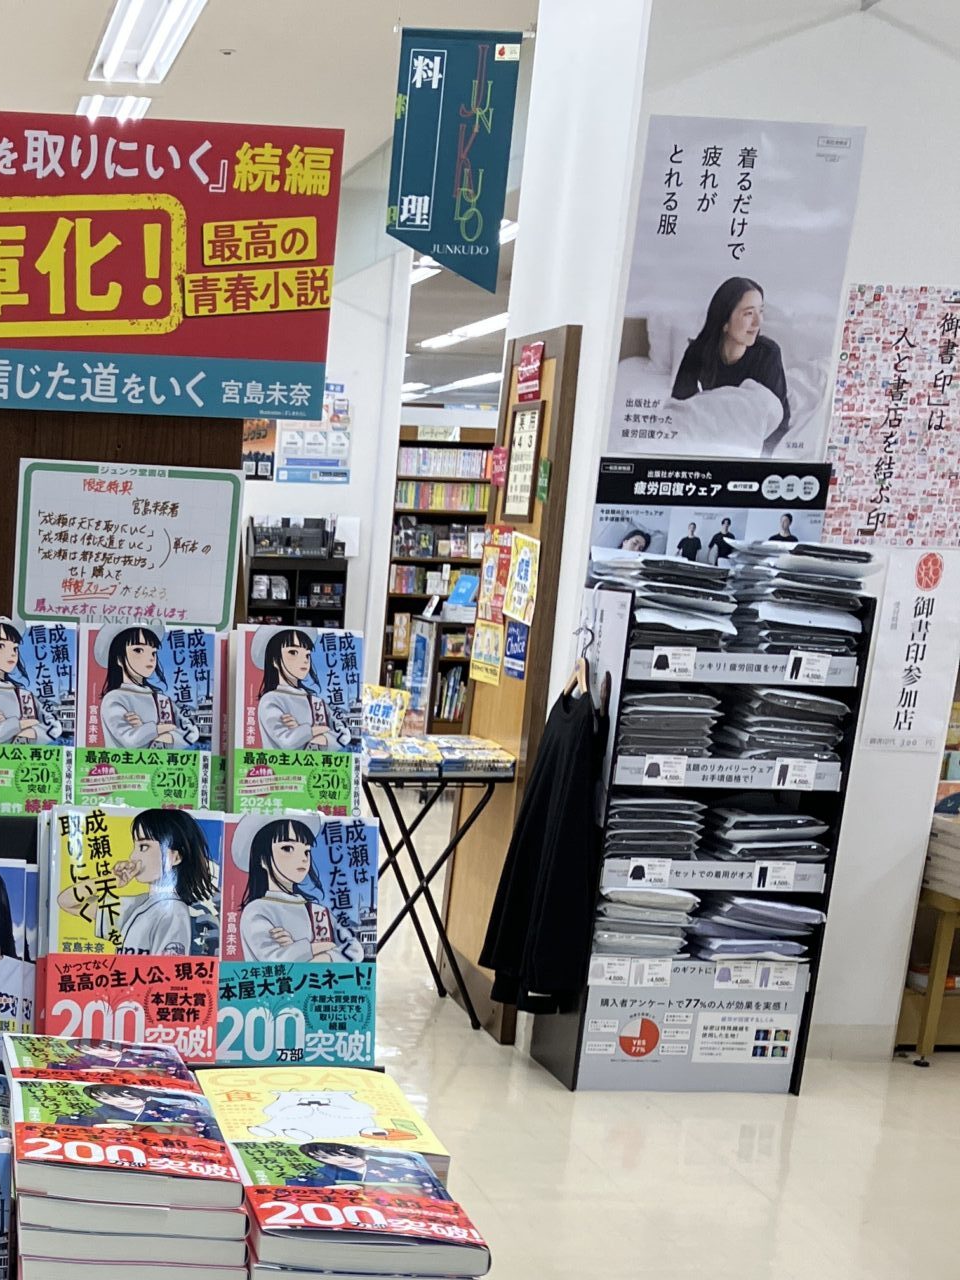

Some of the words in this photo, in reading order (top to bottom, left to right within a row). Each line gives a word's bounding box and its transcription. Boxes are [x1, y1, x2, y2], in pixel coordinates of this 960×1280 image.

[233, 141, 334, 197] 続編
[696, 146, 724, 213] 疲れが
[656, 144, 685, 236] とれる服
[727, 146, 758, 260] 着るだけで
[207, 222, 310, 263] 最高の
[430, 243, 489, 255] JUNKUDO
[187, 270, 330, 312] 青春小説
[221, 379, 312, 407] 宮島未奈
[625, 398, 661, 409] 出版社が
[621, 428, 679, 440] 疲労回復ウェア
[624, 414, 673, 425] 本気で作った
[867, 327, 916, 531] 人と書店を結ぶ印
[101, 466, 167, 478] ジュンク堂書店
[633, 480, 722, 497] 疲労回復ウェア
[647, 469, 713, 480] 出版社が本気で作った
[49, 625, 69, 679] 成瀬は
[187, 629, 209, 682] 成瀬は
[339, 631, 359, 685] 成瀬は
[893, 597, 935, 731] 御書印参加店
[28, 625, 57, 741] 信じた道をいく
[167, 629, 194, 746] 信じた道をいく
[319, 632, 348, 748] 信じた道をいく
[85, 751, 198, 767] 最高の主人公、再び!
[243, 752, 352, 768] 最高の主人公、再び!
[346, 820, 369, 885] 成瀬は
[85, 809, 121, 947] 成瀬は天下を
[321, 822, 356, 962] 信じた道をいく
[62, 942, 105, 954] 宮島未奈
[226, 911, 237, 955] 宮島未奈
[58, 960, 215, 993] 最高の主人公、現る!
[62, 959, 110, 974] かつてなく
[220, 966, 373, 1001] 本屋大賞ノミネート!
[241, 964, 287, 980] 2年連続
[151, 992, 207, 1008] 本屋大賞
[156, 1008, 200, 1023] 受賞作
[217, 1007, 305, 1060] 200
[276, 1048, 304, 1062] 万部
[305, 1029, 372, 1062] 突破!
[23, 1138, 147, 1165] 200
[148, 1158, 240, 1180] 突破!
[260, 1200, 388, 1227] 200
[387, 1218, 485, 1241] 突破!
